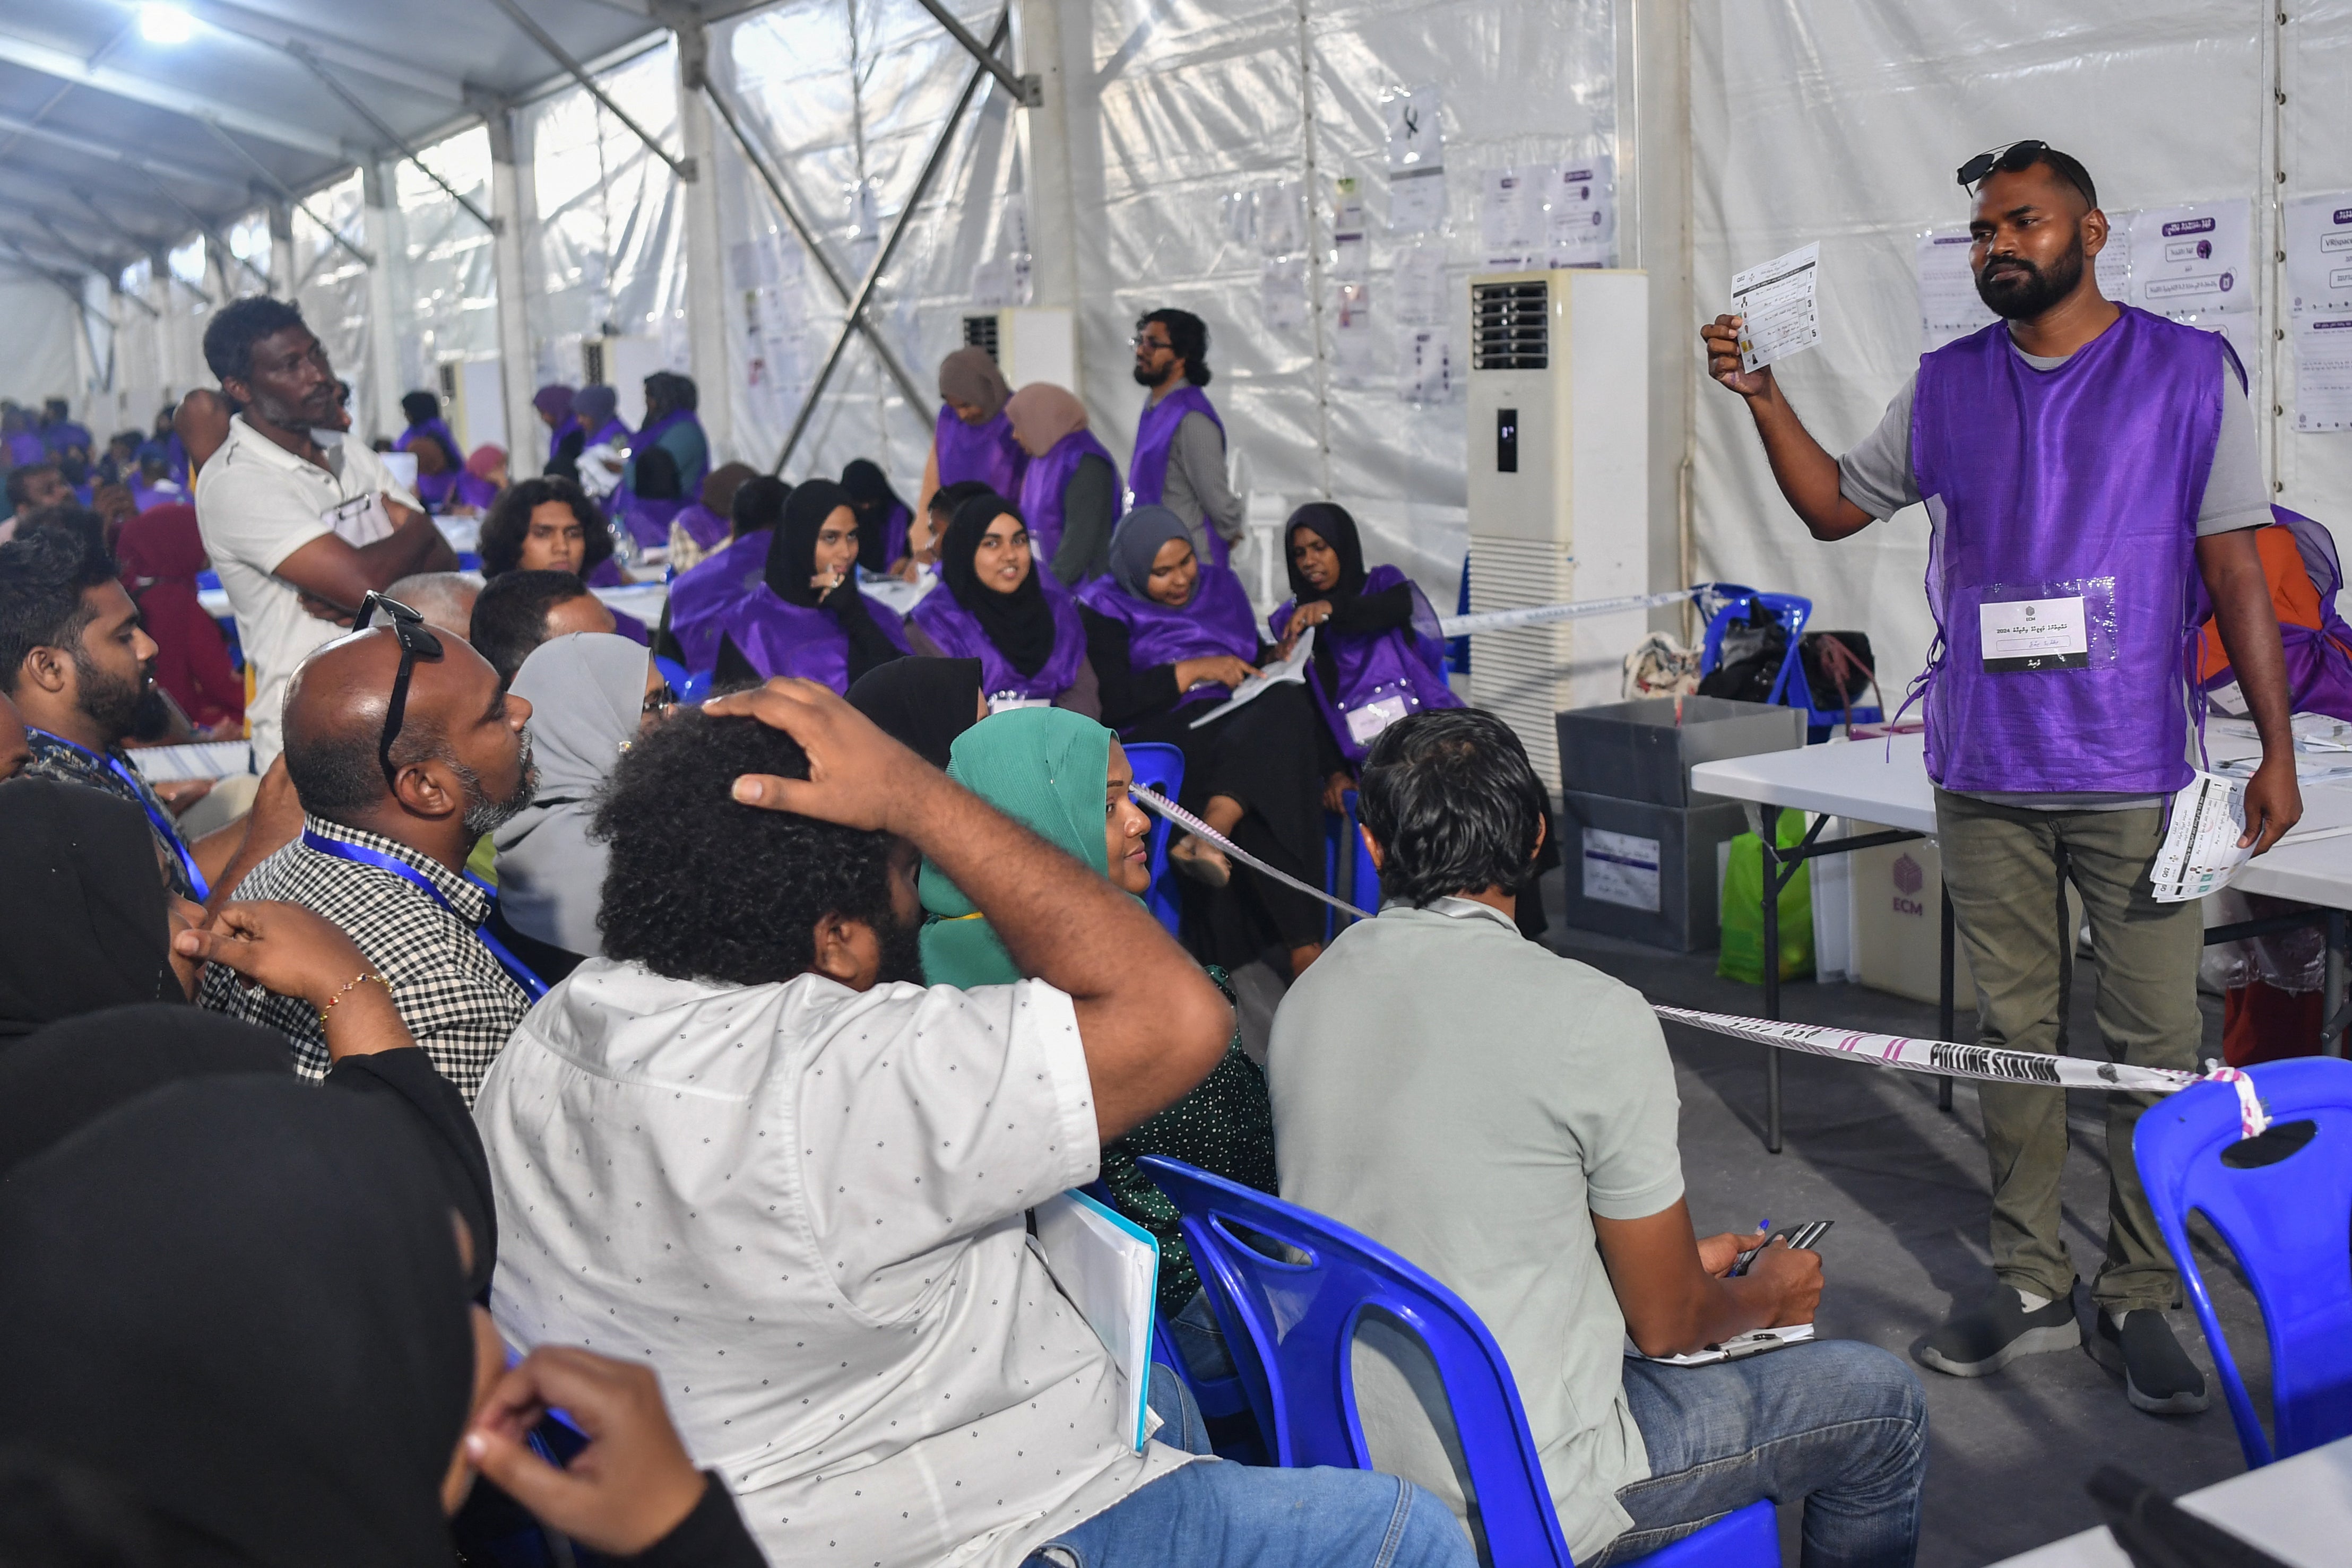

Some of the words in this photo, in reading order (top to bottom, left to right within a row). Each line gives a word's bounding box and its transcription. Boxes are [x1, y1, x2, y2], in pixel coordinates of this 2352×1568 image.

[1812, 329, 1817, 337] 5
[1893, 897, 1922, 916] ECM
[1930, 1043, 1991, 1073] POLLING
[1992, 1051, 2061, 1083] STATION
